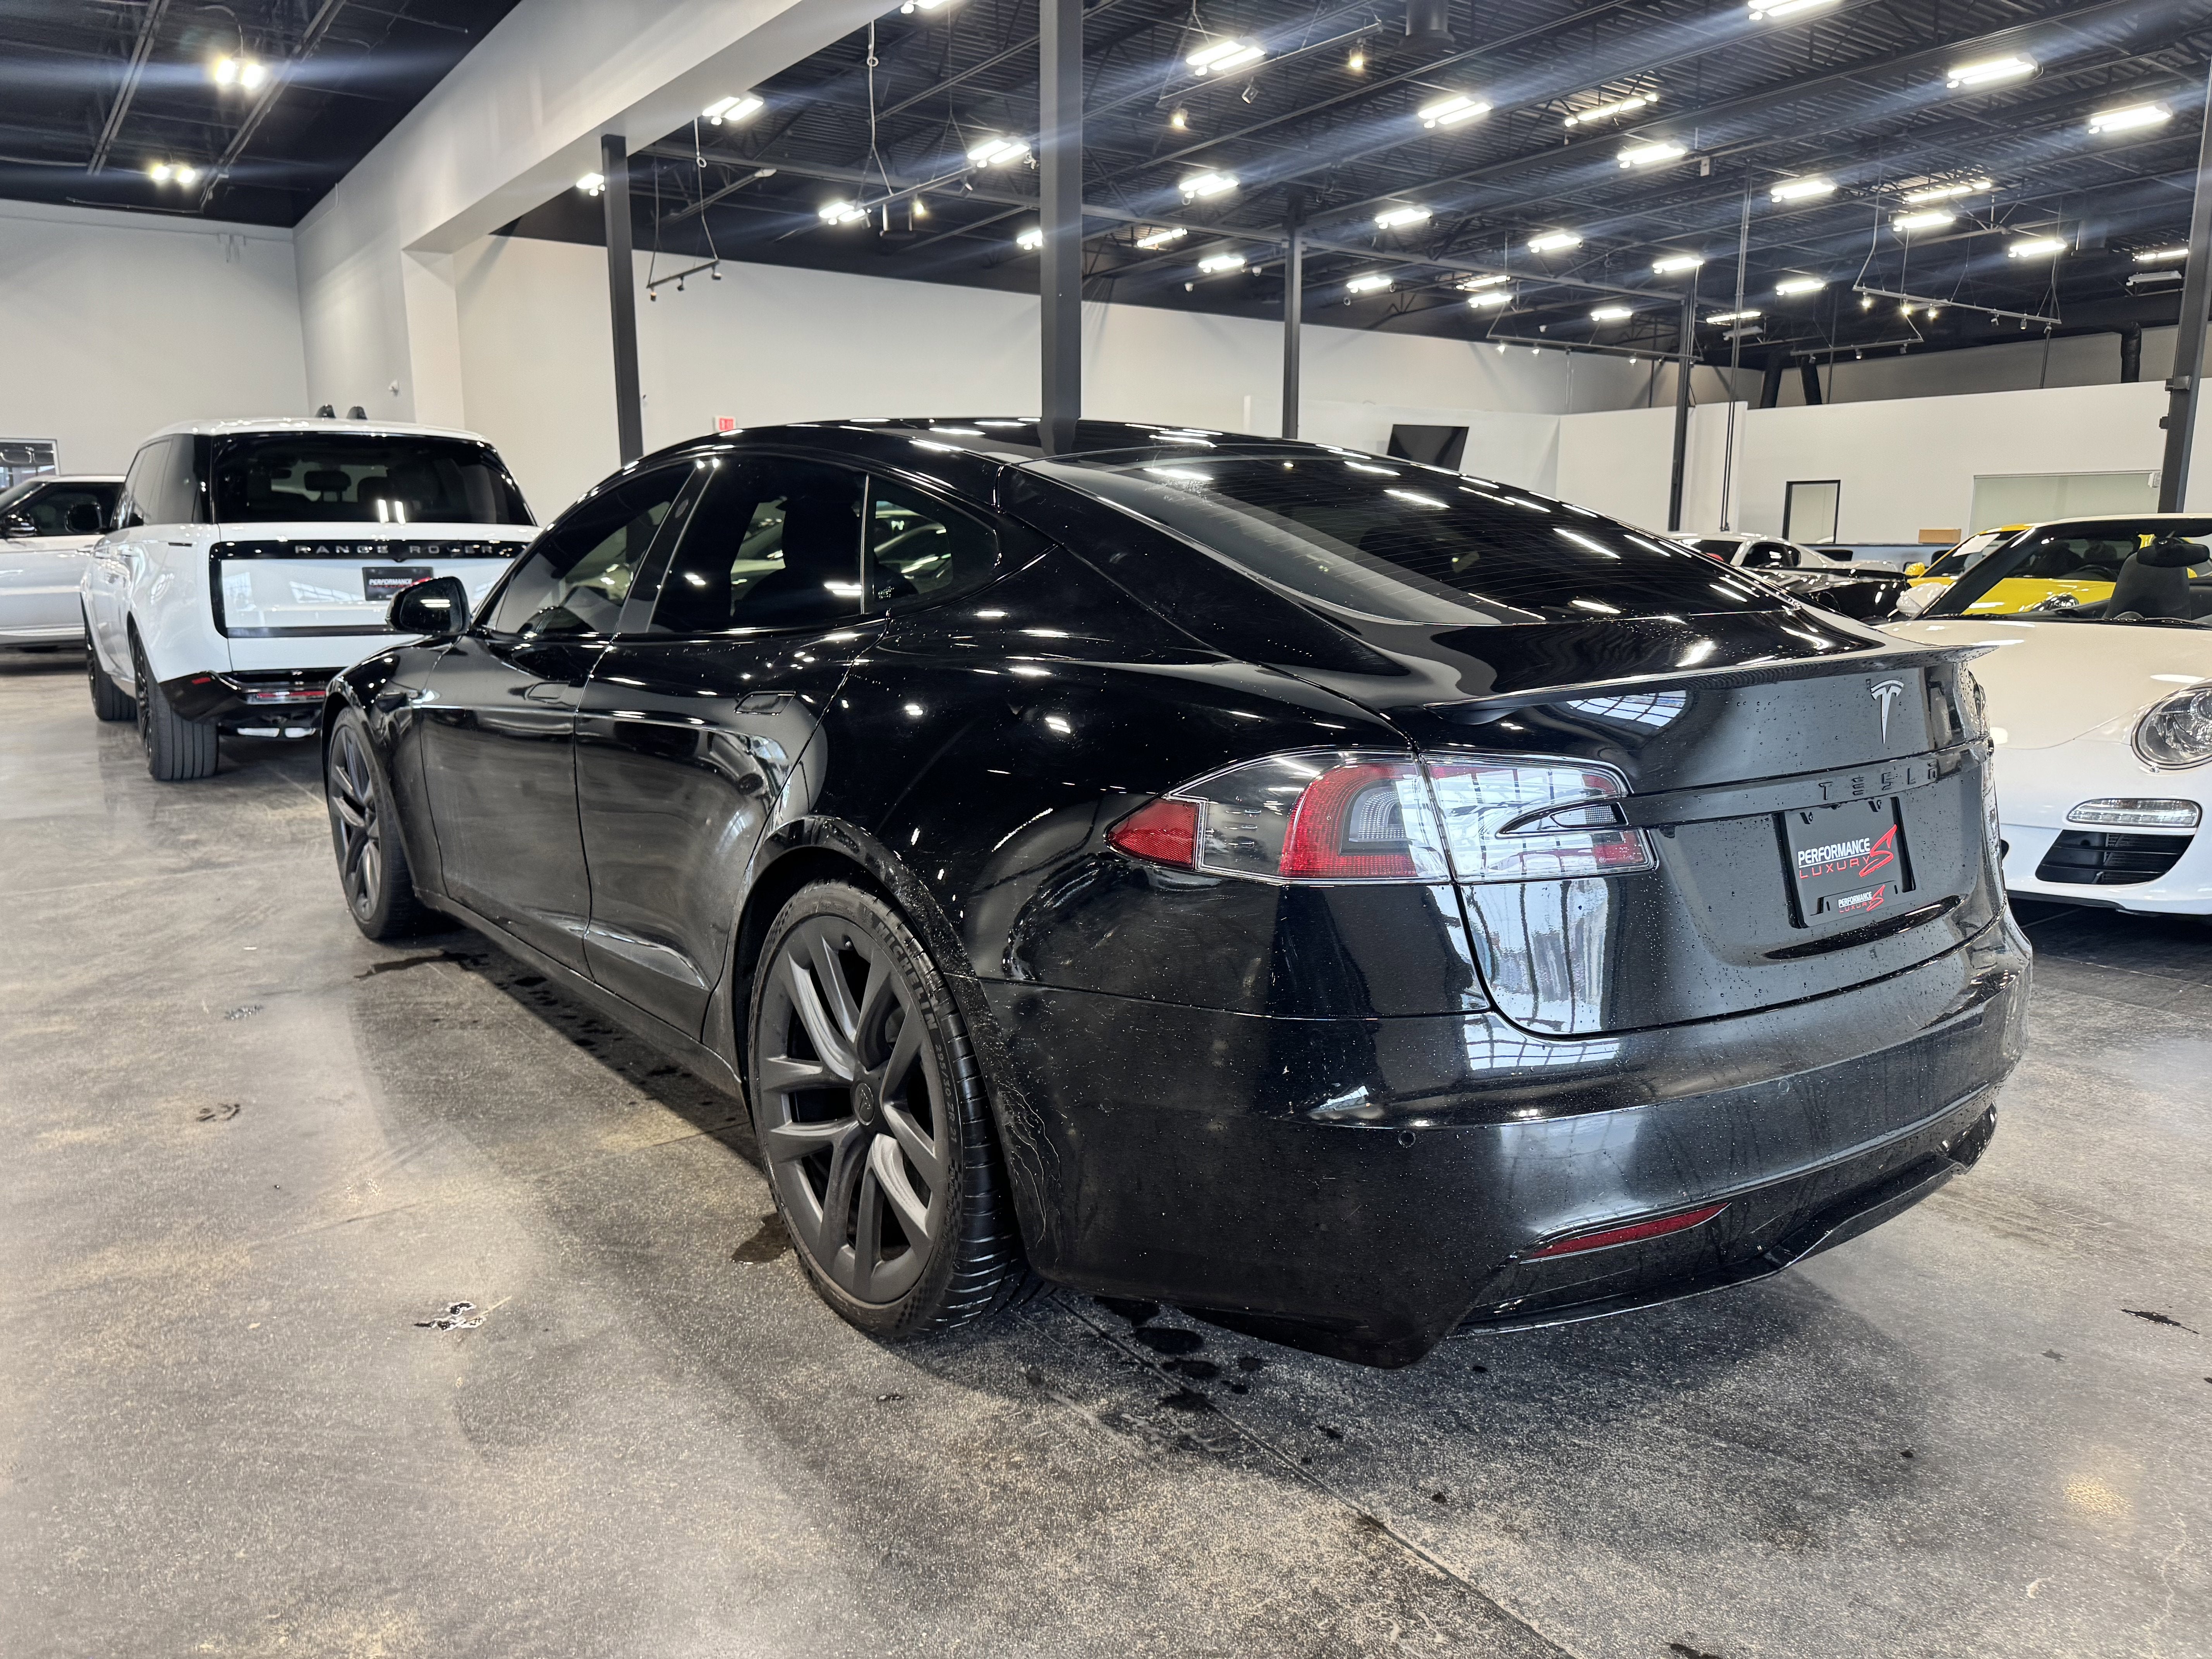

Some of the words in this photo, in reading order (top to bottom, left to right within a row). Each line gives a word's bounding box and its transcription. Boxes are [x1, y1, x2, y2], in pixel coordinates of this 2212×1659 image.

[295, 545, 388, 554] RANGE
[1818, 761, 1938, 800] TESLA
[1798, 837, 1870, 866] PERFORMANCE
[1799, 855, 1870, 879] LUXURY
[1838, 891, 1872, 906] PERFORMANCE
[876, 922, 938, 1030] MICHELIN
[935, 1044, 951, 1097] 295/30
[950, 1126, 957, 1143] 21
